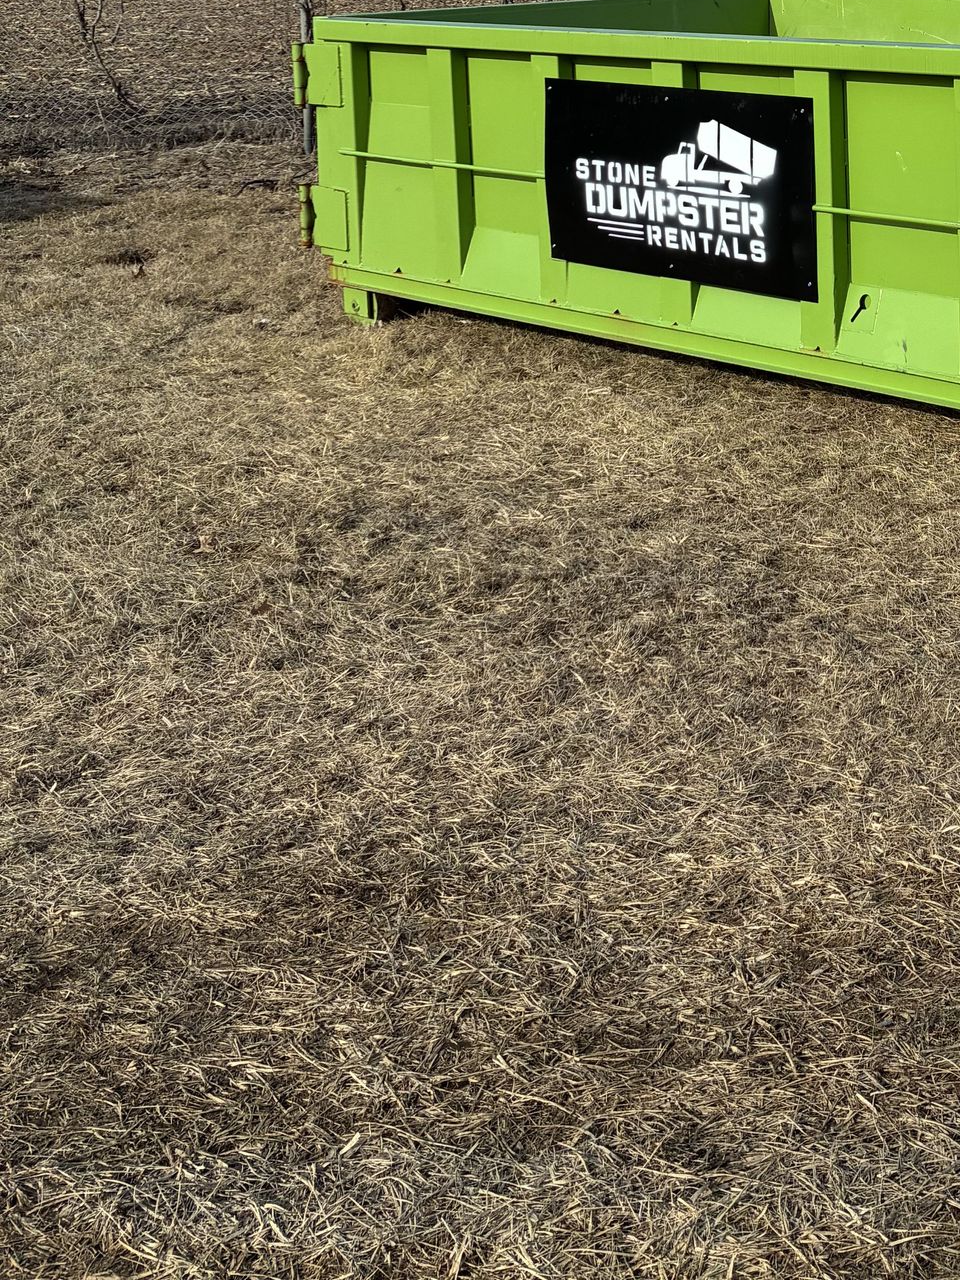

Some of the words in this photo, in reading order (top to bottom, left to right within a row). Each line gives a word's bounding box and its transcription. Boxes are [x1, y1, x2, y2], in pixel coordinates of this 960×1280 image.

[575, 157, 657, 188] STONE
[585, 182, 765, 237] DUMPSTER
[646, 224, 767, 263] RENTALS
